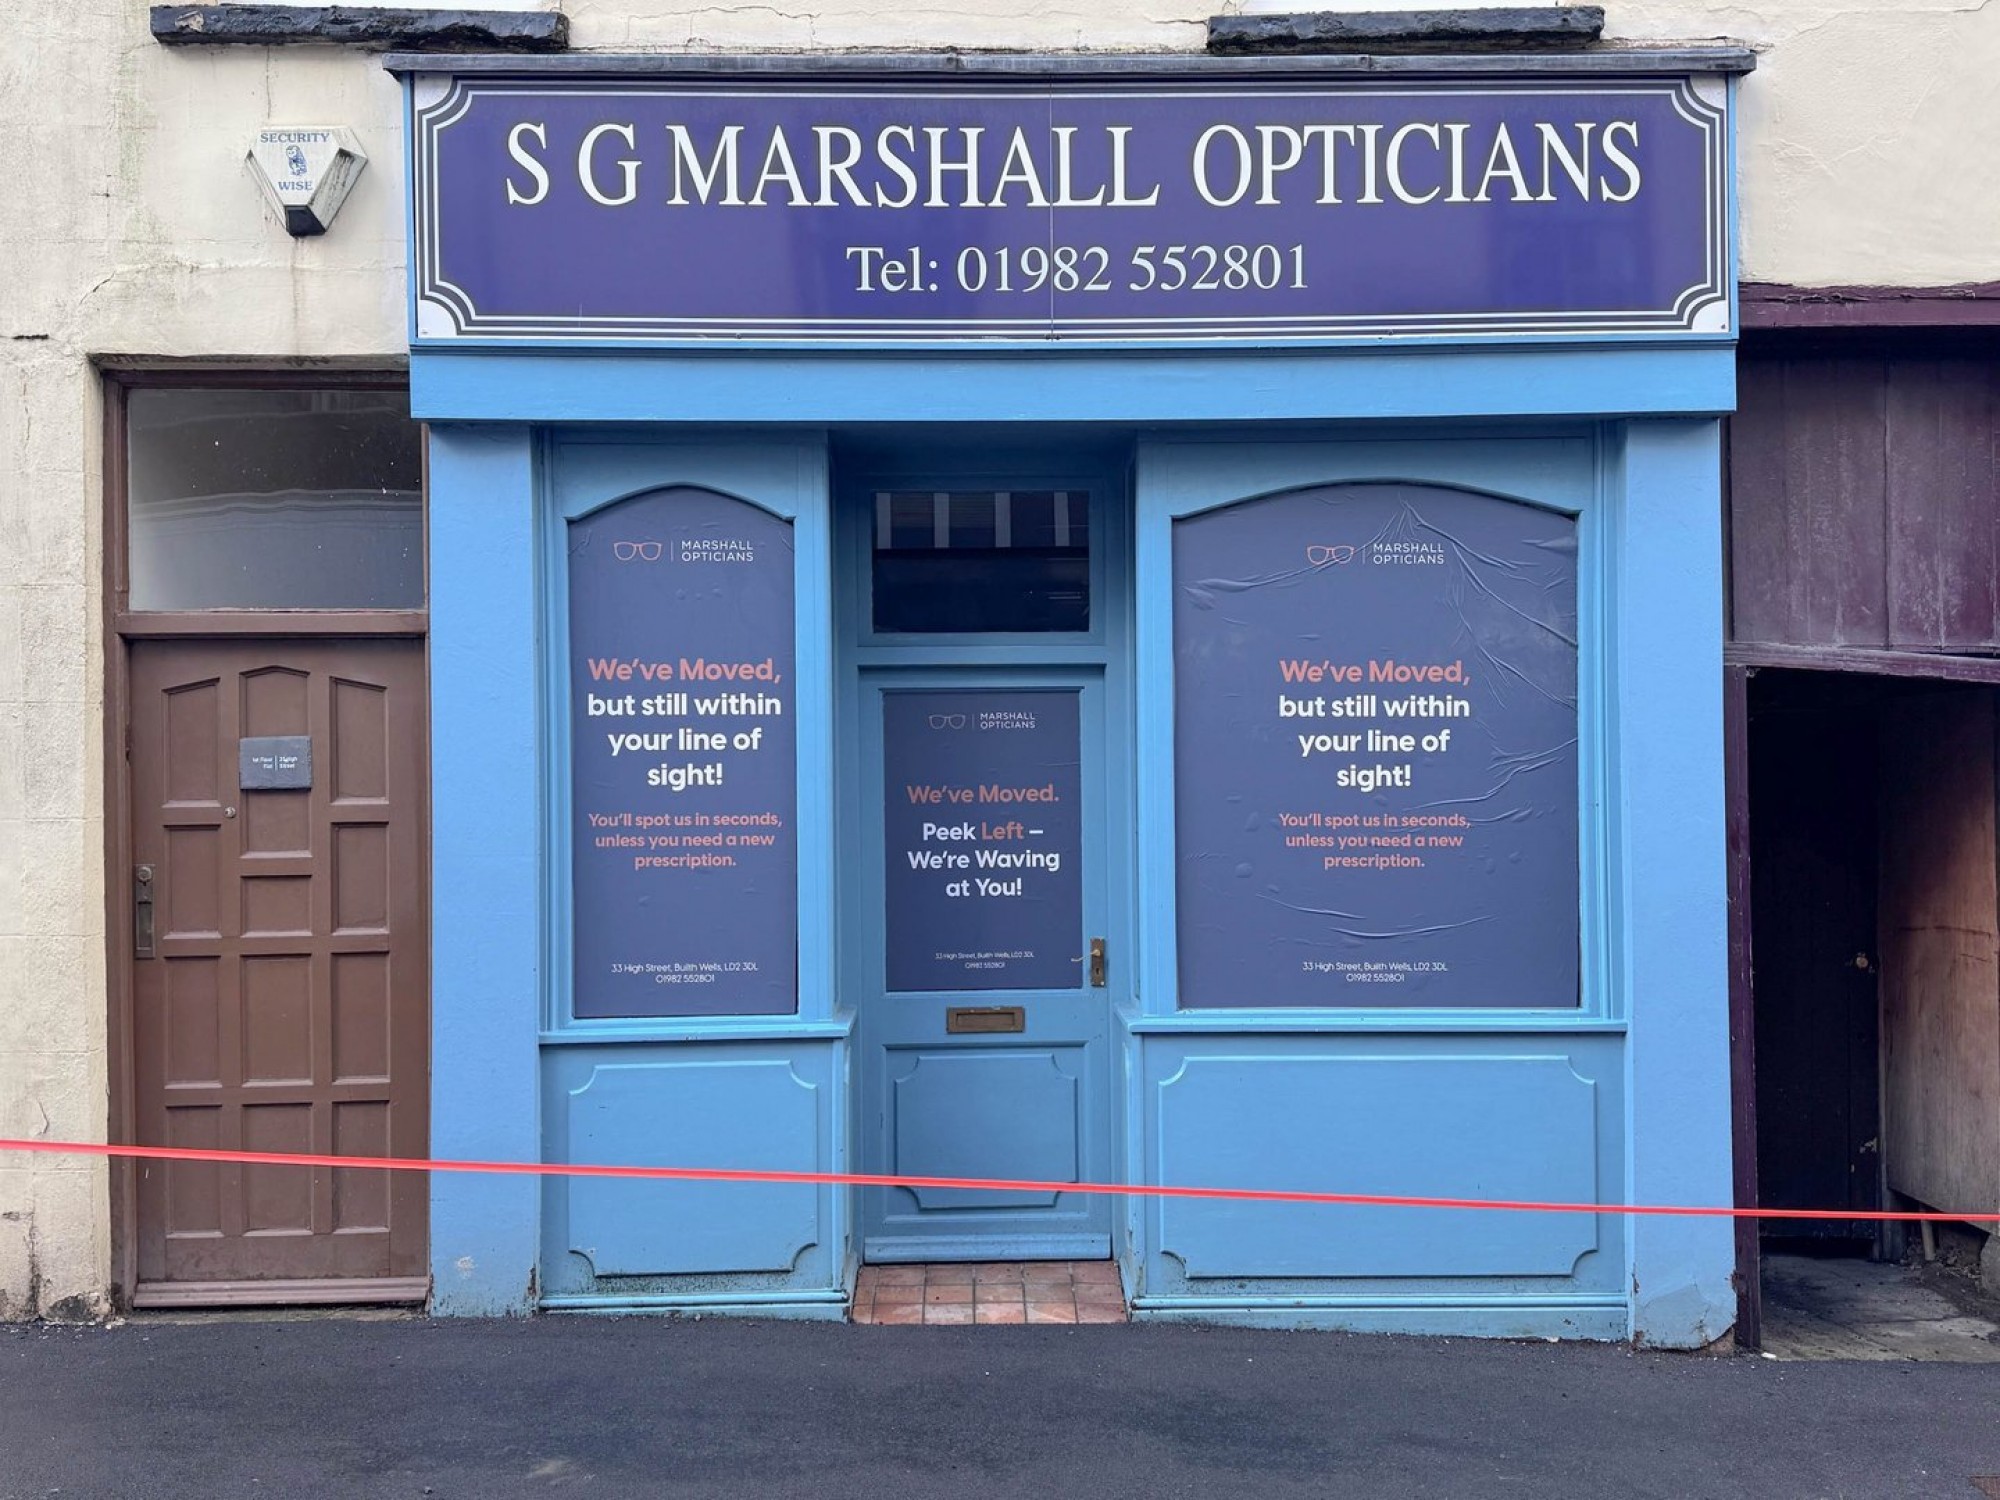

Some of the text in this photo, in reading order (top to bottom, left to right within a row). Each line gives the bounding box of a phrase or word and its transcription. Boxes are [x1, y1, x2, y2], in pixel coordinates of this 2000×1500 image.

[260, 132, 330, 144] SECURITY
[507, 121, 1640, 208] S G MARSHALL OPTICIANS
[277, 181, 313, 192] WISE
[846, 244, 1308, 292] Tel: 01982 552801
[681, 540, 753, 551] MARSHALL
[1373, 542, 1444, 554] MARSHALL
[682, 551, 753, 562] OPTICIANS
[1373, 554, 1444, 565] OPTICIANS
[588, 658, 781, 684] We've Moved,
[1280, 660, 1470, 686] We've Moved,
[588, 693, 781, 716] but still within
[1280, 695, 1469, 717] but still within
[980, 712, 1035, 720] MARSHALL
[980, 721, 1036, 729] OPTICIANS
[608, 727, 762, 756] your line of
[1298, 729, 1450, 757] your line of
[648, 763, 722, 791] sight!
[1337, 764, 1411, 792] sight!
[907, 784, 1059, 803] We've Moved.
[589, 812, 782, 829] You'll spot us in seconds,
[1279, 813, 1471, 829] You'll spot us in seconds,
[923, 822, 976, 840] Peek
[981, 822, 1024, 841] Left
[596, 833, 775, 850] unless you need a new
[1286, 834, 1463, 850] unless you need a new
[635, 853, 736, 870] prescription.
[908, 849, 1060, 872] We're Waving
[1325, 854, 1425, 870] prescription.
[946, 878, 1022, 897] at You!
[611, 962, 758, 974] 33 High Street, Builth Wells, LD2 3DL
[1303, 962, 1447, 972] 33 High Street, Builth Wells, LD2 3DL
[655, 974, 715, 983] 01982 552801
[1346, 973, 1405, 983] 01982 552801
